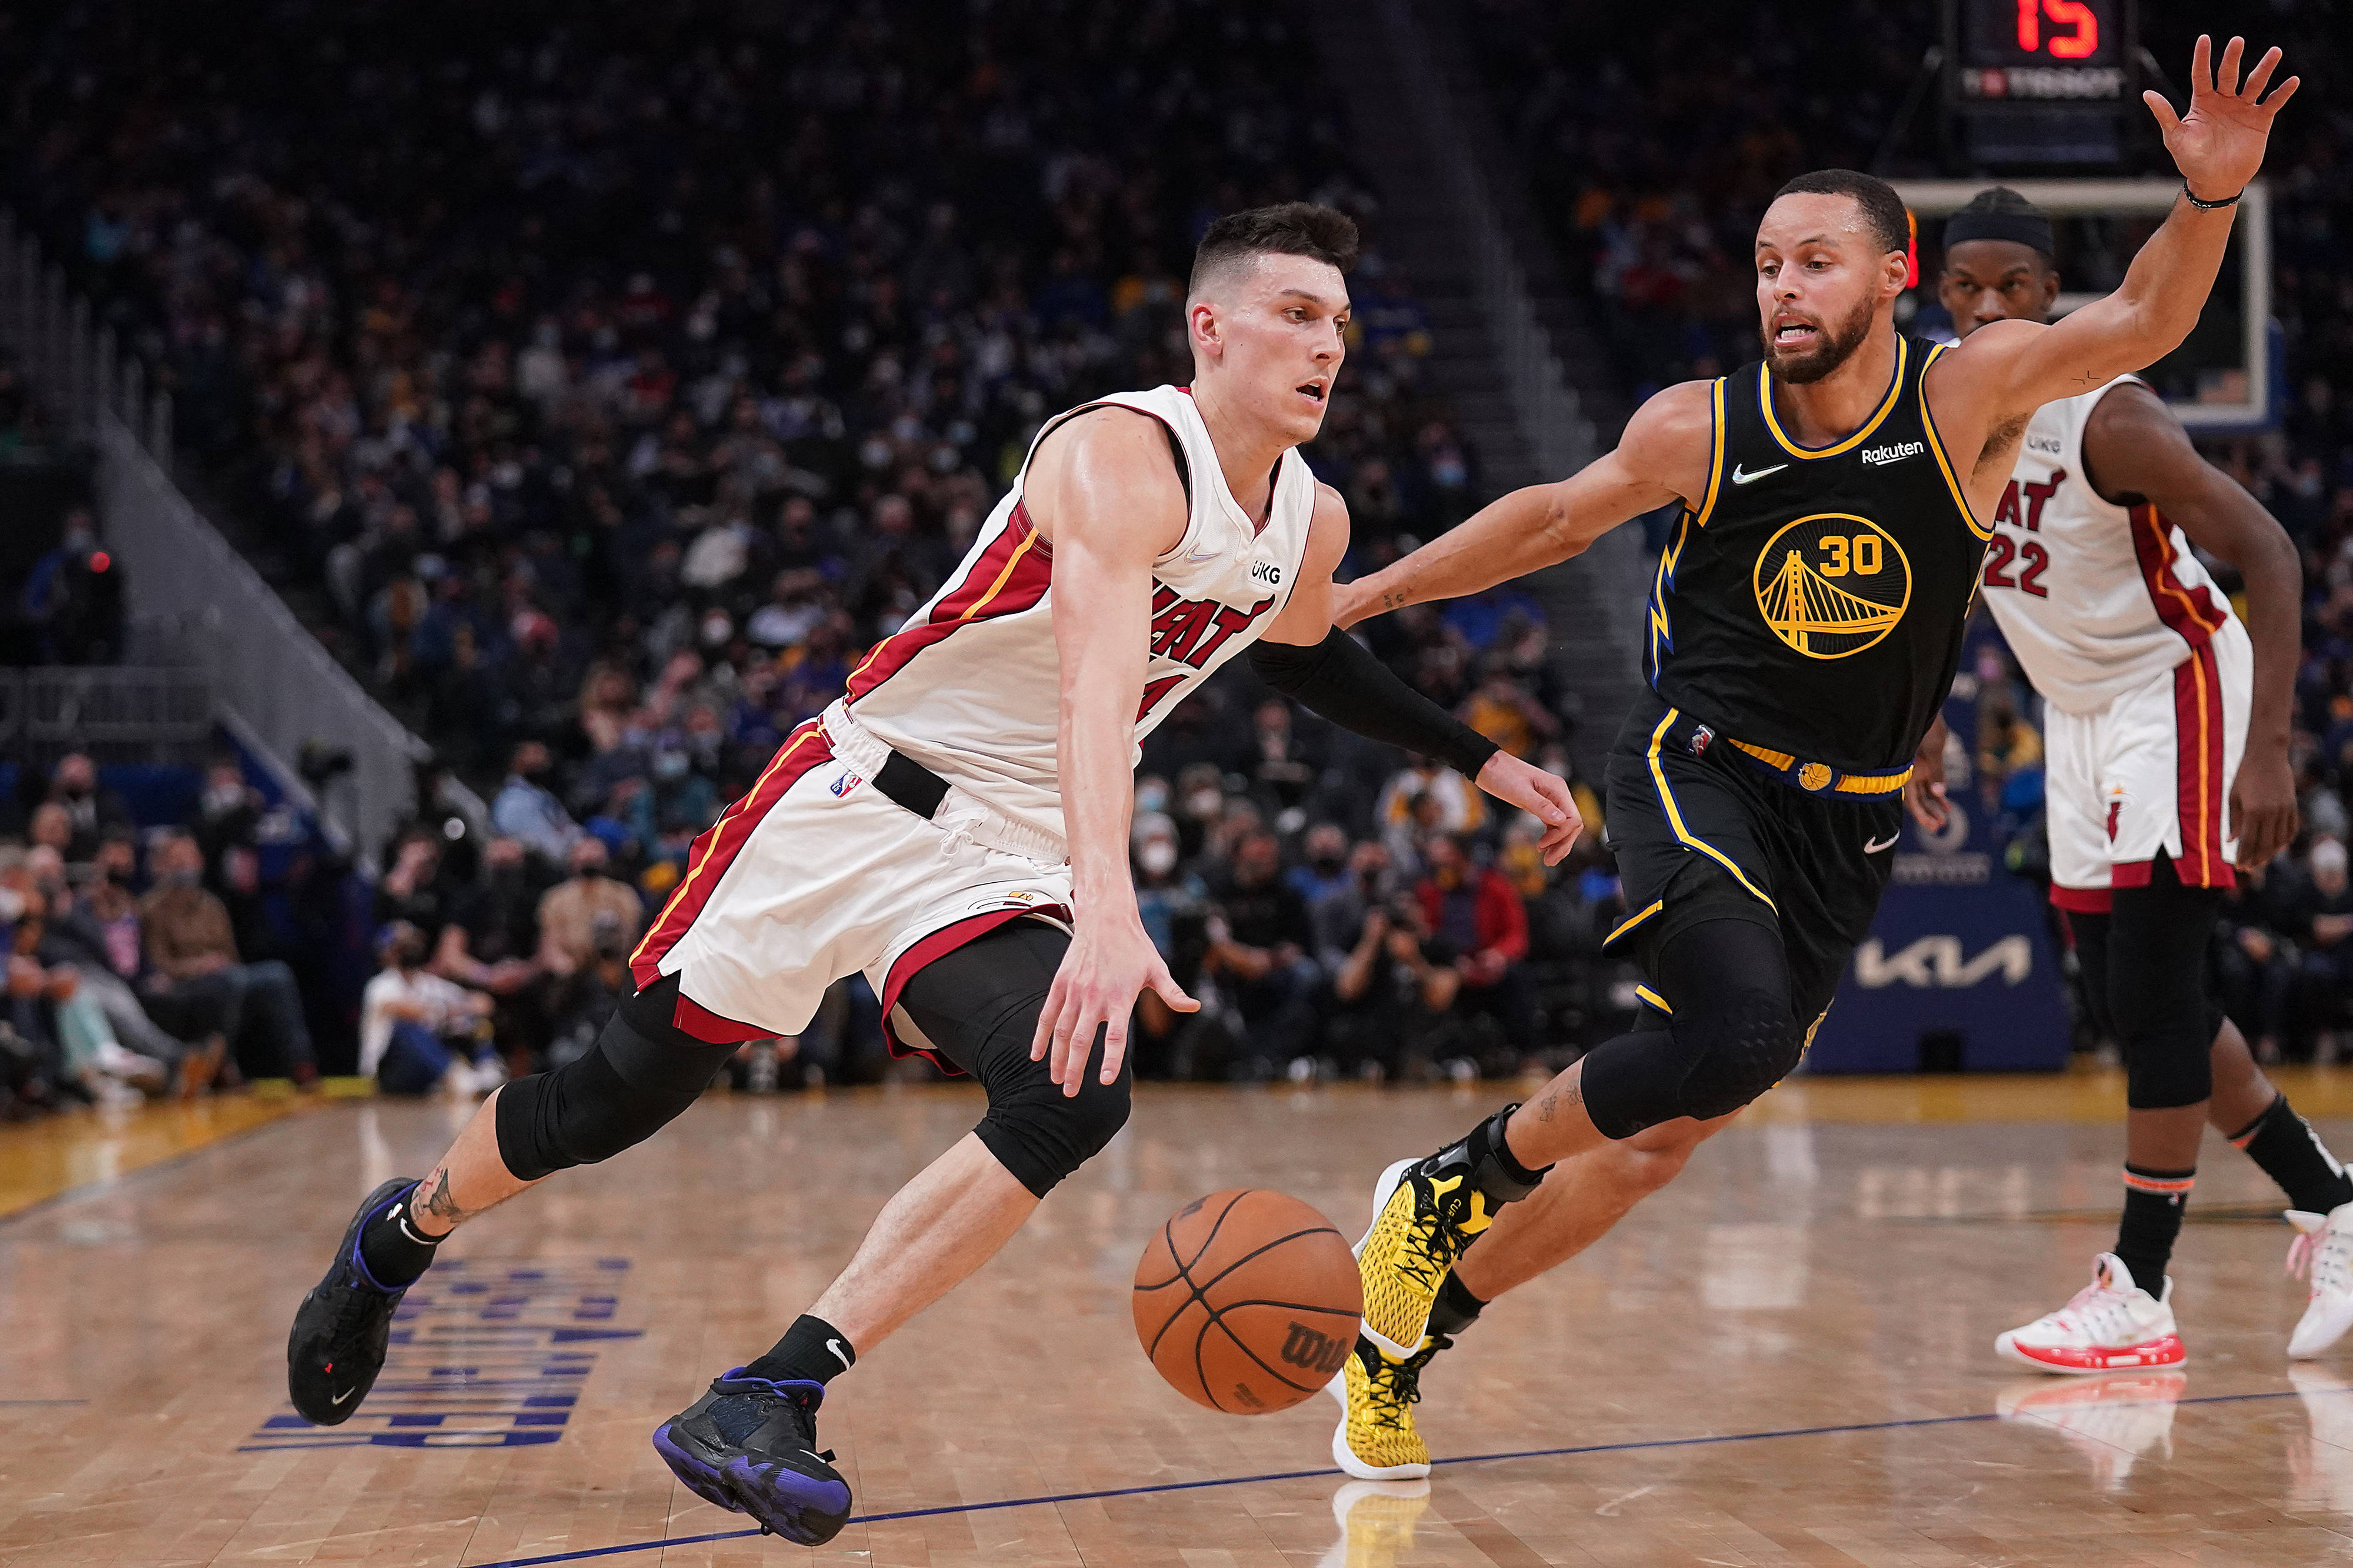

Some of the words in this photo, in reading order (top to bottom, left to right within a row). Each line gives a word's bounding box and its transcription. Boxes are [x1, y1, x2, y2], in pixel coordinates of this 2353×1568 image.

[2017, 0, 2098, 58] 15
[1862, 441, 1924, 465] Rakuten
[1995, 468, 2067, 532] AT
[1819, 534, 1883, 577] 30
[1983, 533, 2049, 598] 22
[1149, 574, 1276, 671] EAT
[1448, 1198, 1462, 1217] CUR
